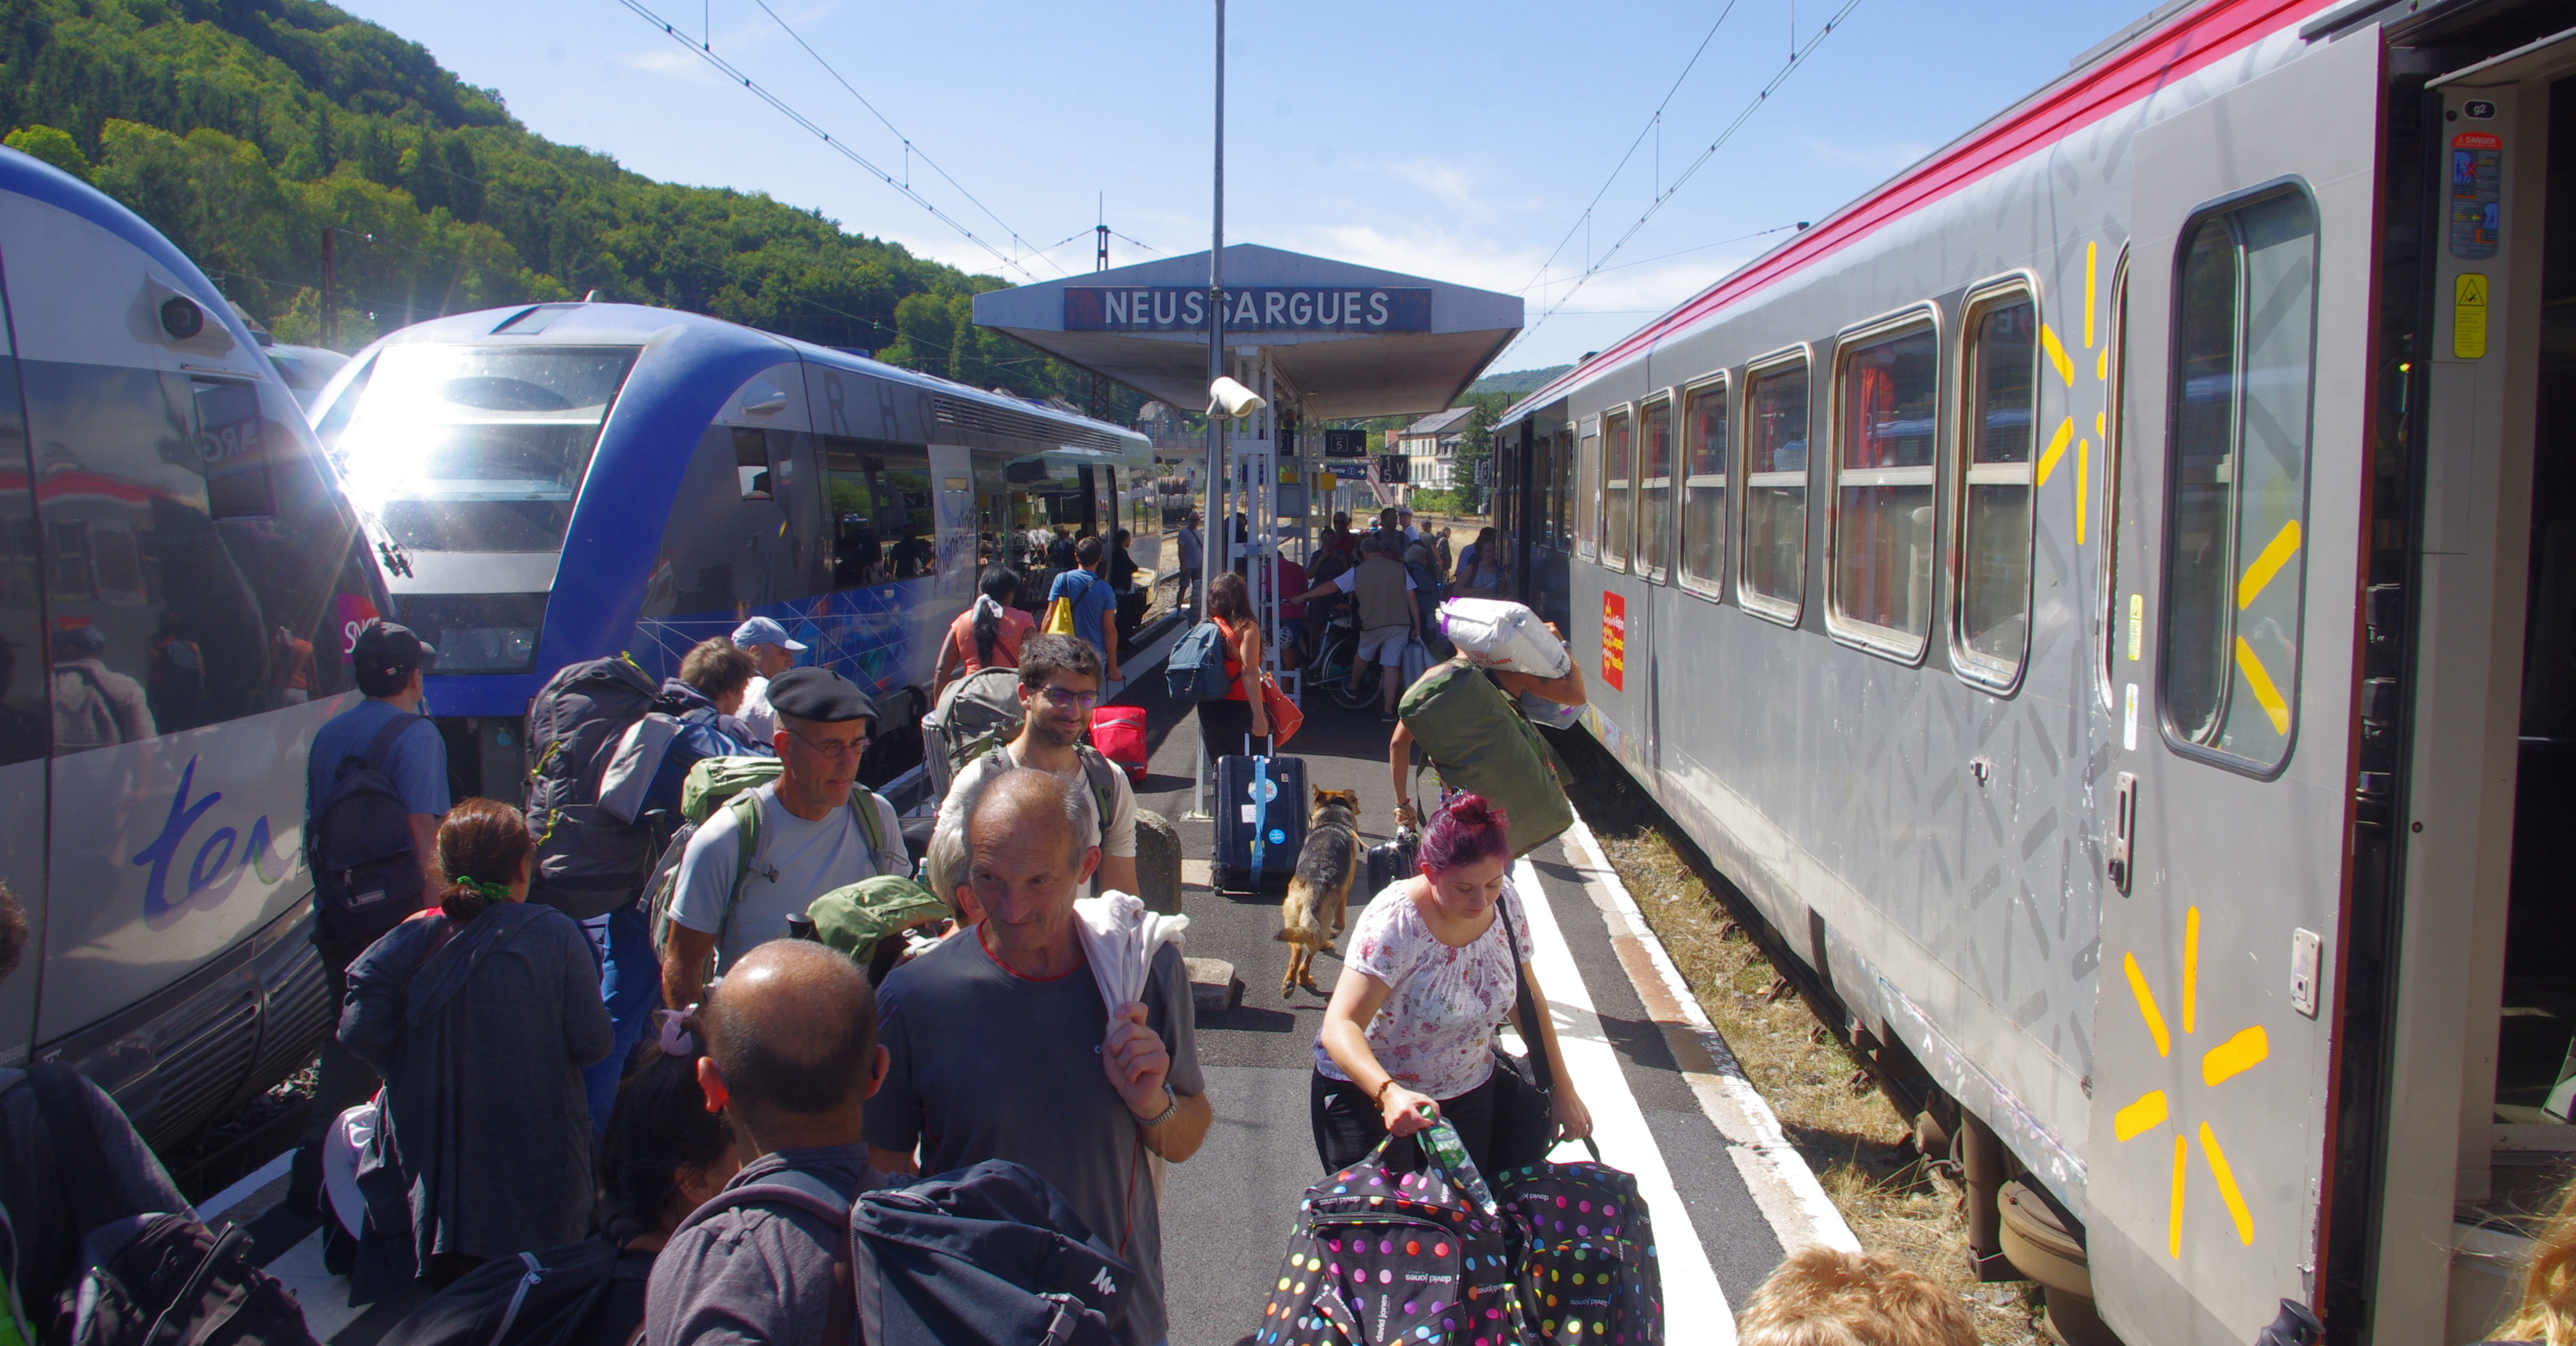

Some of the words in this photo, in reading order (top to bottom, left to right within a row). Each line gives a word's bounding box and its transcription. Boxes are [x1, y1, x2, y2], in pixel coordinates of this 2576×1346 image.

[2473, 105, 2486, 115] g2
[1336, 440, 1343, 449] 5
[1385, 455, 1391, 469] 1
[1384, 469, 1391, 483] 5
[1396, 462, 1405, 476] V
[1486, 657, 1512, 666] CANIN
[132, 754, 299, 932] ter
[1340, 1196, 1361, 1205] david
[1530, 1193, 1549, 1202] david
[1405, 1273, 1429, 1284] jones
[1429, 1274, 1451, 1284] david
[1378, 1294, 1388, 1319] jones
[1570, 1298, 1590, 1308] jones
[1375, 1318, 1386, 1343] david
